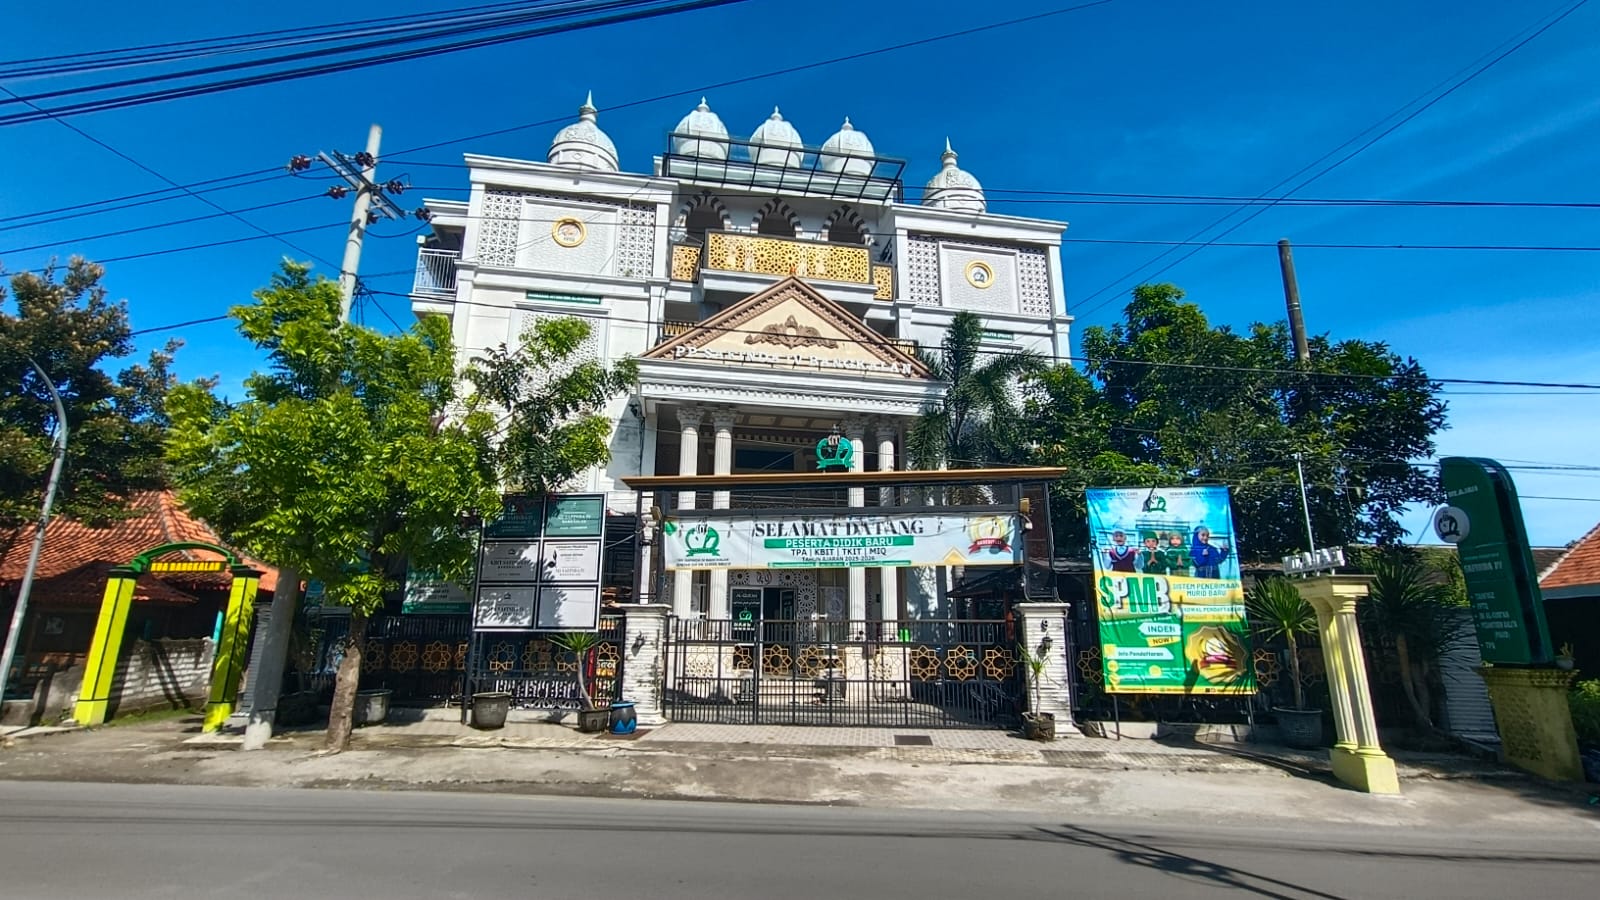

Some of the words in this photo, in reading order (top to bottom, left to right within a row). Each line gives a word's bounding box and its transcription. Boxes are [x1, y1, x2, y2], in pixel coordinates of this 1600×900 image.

[754, 521, 840, 537] SELAMAT
[846, 519, 924, 536] DATANG
[786, 538, 831, 548] PESERTA
[832, 537, 863, 547] DIDIK
[865, 536, 894, 546] BARU
[791, 548, 807, 556] TPA
[815, 548, 835, 556] KBIT
[842, 547, 862, 556] TKIT
[1099, 575, 1171, 615] SPMB
